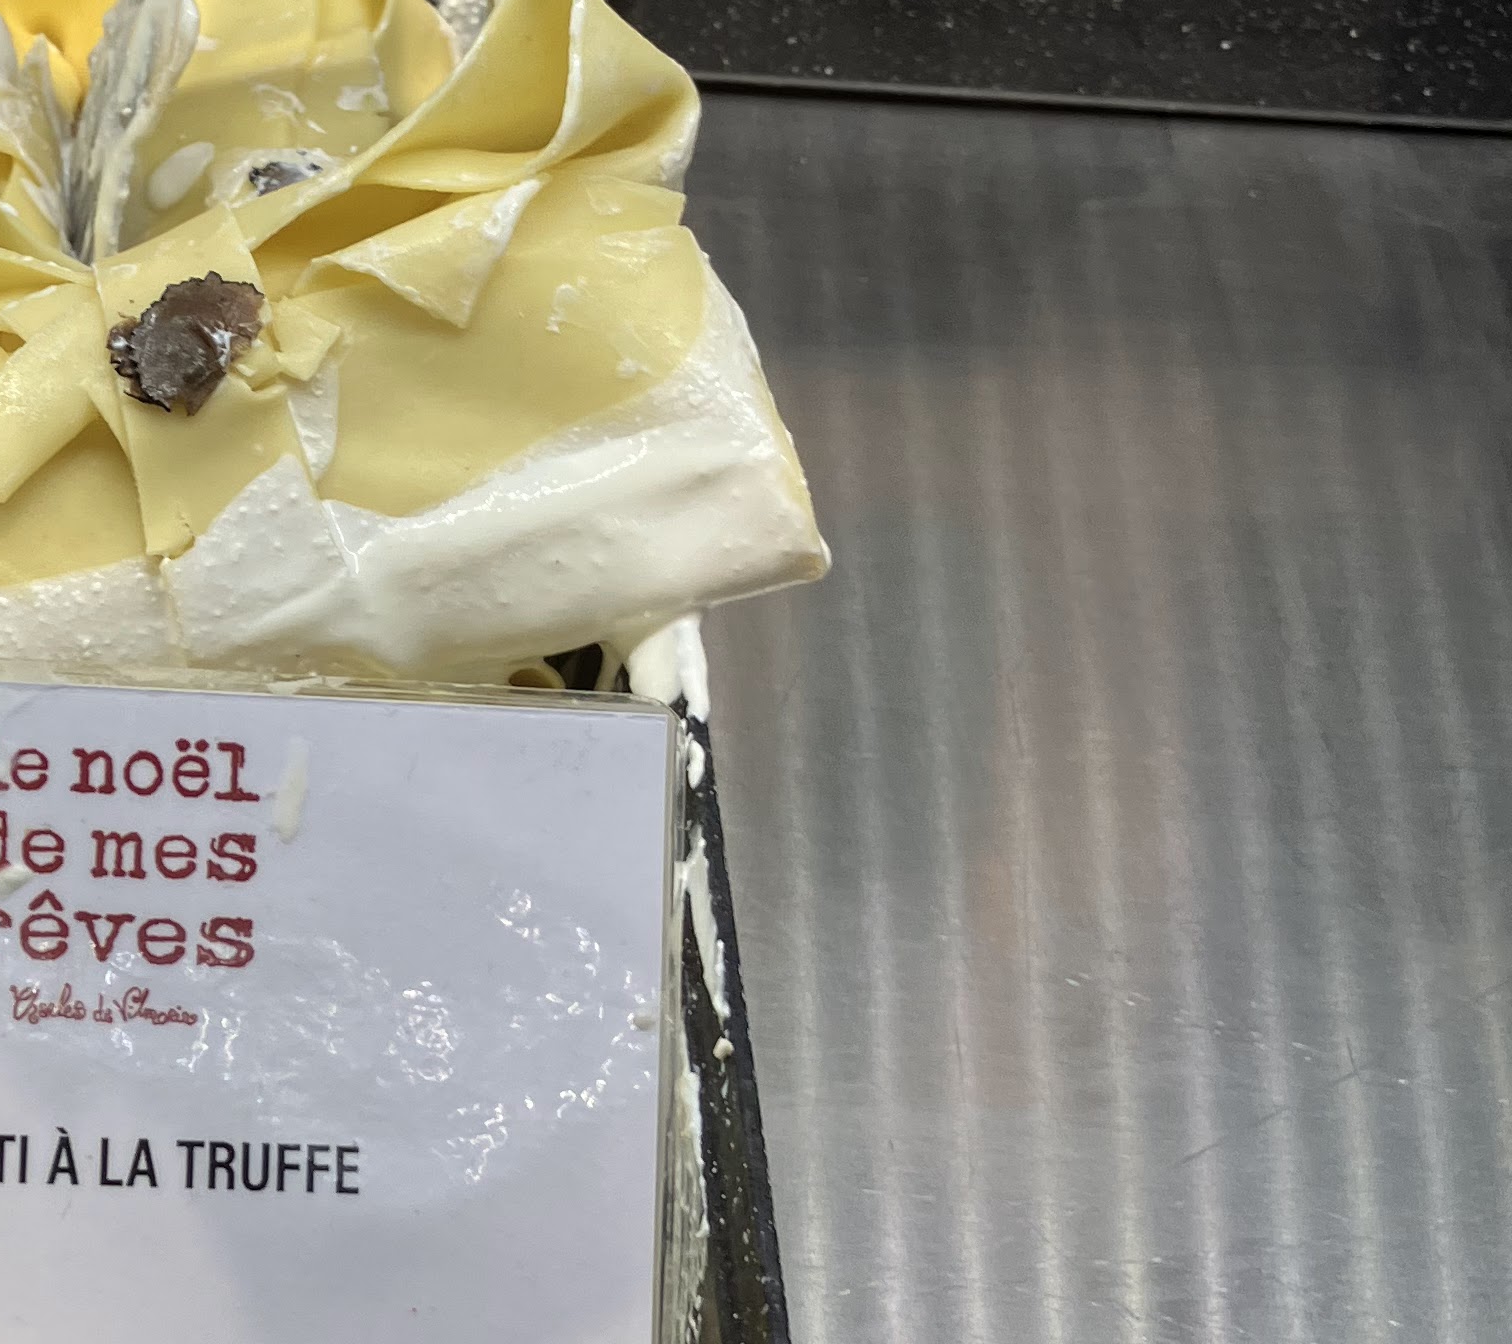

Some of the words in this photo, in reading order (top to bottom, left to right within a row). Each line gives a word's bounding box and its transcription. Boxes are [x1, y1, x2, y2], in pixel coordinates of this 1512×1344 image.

[69, 738, 261, 802] noël
[90, 829, 258, 883] mes
[45, 1127, 80, 1186] À
[98, 1137, 160, 1188] LA
[176, 1140, 361, 1195] TRUFFE
